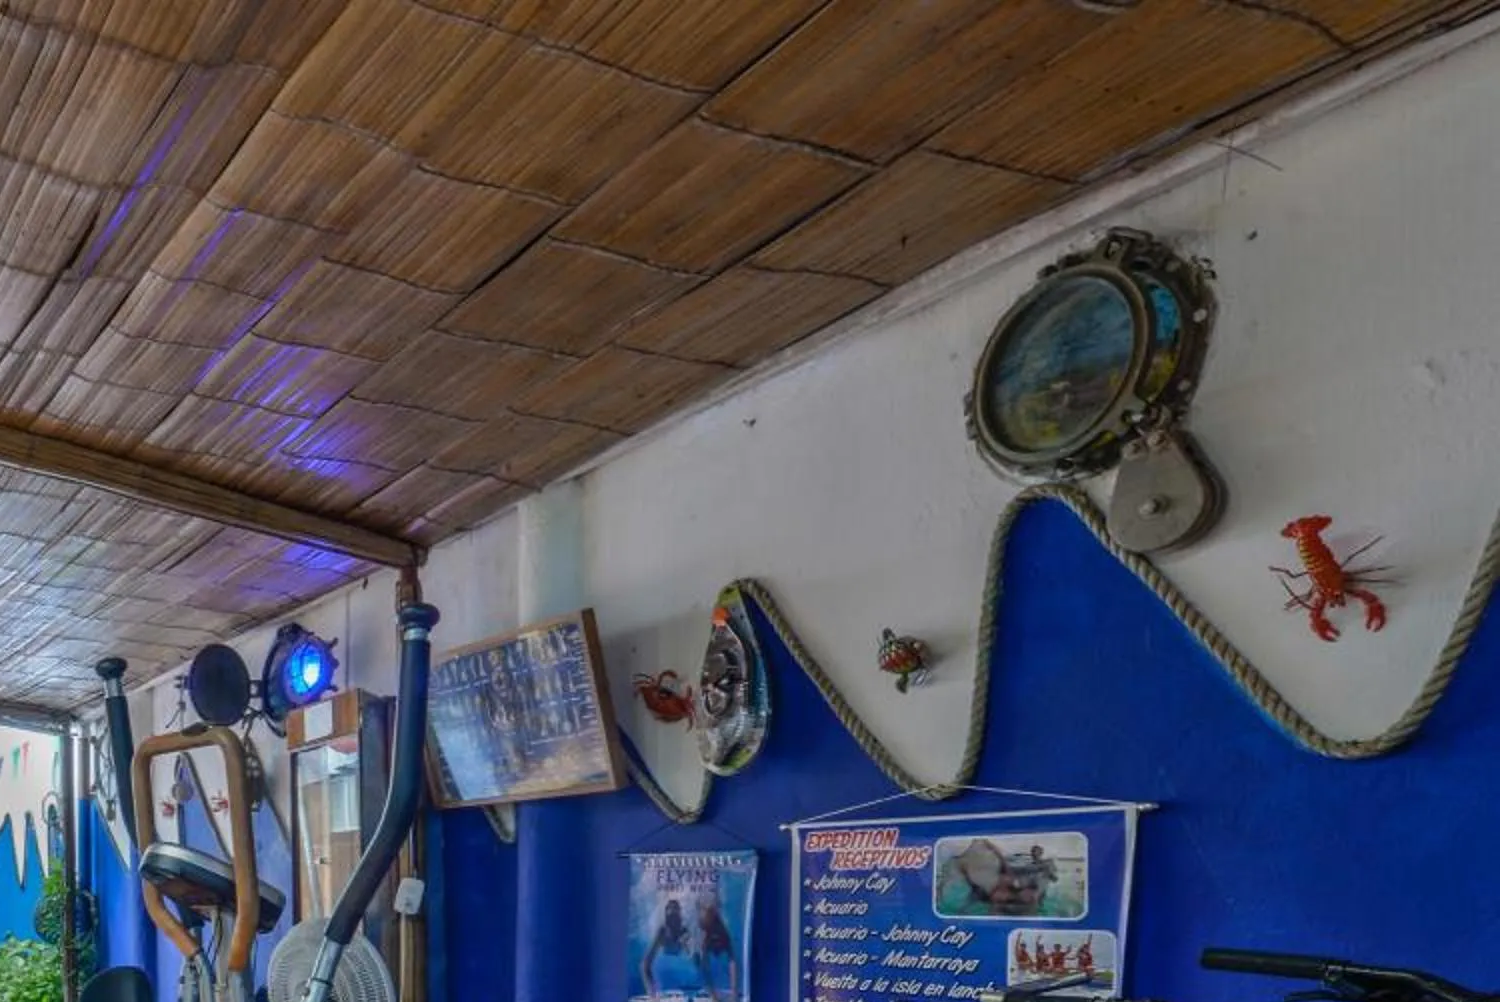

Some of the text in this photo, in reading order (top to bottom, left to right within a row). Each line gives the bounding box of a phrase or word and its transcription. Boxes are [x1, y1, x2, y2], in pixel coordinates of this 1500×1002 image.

[806, 830, 898, 852] EXPEDITION
[832, 848, 931, 870] RECEPTIVOS
[813, 871, 896, 894] Johnny Cay
[813, 898, 869, 916] Acuario
[814, 922, 868, 941] Acuario
[882, 924, 940, 947] Johnny
[940, 925, 973, 948] Cay
[814, 947, 869, 966] Acuario
[881, 950, 980, 976] Mantarraya
[814, 972, 859, 990] Vuelta
[859, 979, 872, 991] a
[873, 977, 890, 992] la
[923, 983, 945, 996] en
[948, 981, 1000, 999] lanch
